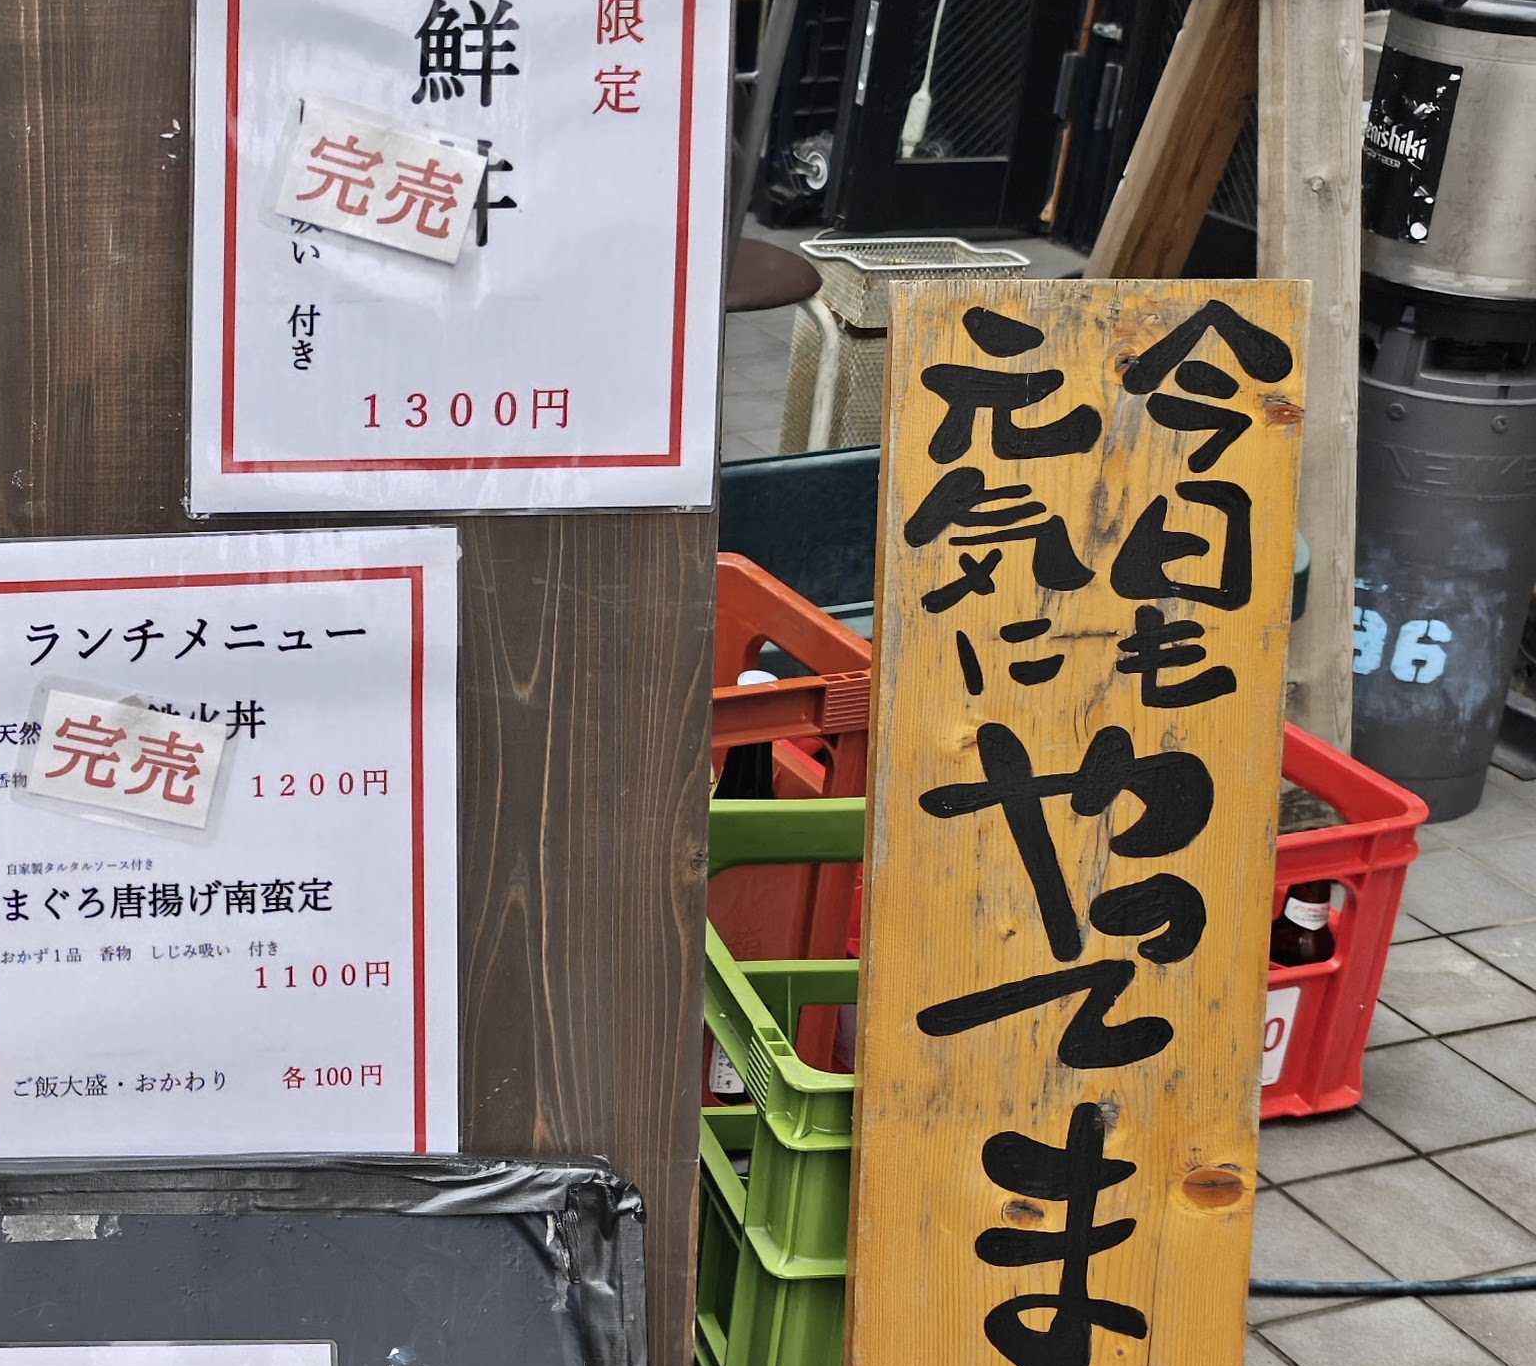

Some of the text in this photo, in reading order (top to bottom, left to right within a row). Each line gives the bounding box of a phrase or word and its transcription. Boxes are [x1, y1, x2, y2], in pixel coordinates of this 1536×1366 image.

[295, 131, 465, 240] 完売
[287, 303, 320, 371] 付き
[363, 386, 574, 432] 1300円
[902, 305, 1102, 696] 元気に
[1109, 297, 1294, 710] 今日も
[25, 618, 368, 667] ランチメニュー
[44, 714, 205, 806] 完売
[251, 771, 389, 799] 1200円
[6, 858, 153, 876] 自家製タルタルソース付き
[2, 877, 333, 922] まぐろ唐揚げ南蛮定
[1, 941, 279, 964] おかず1品 香物 しじみ吸い 付き
[254, 960, 392, 989] 1100円
[12, 1069, 229, 1099] ご飯大盛・おかわり
